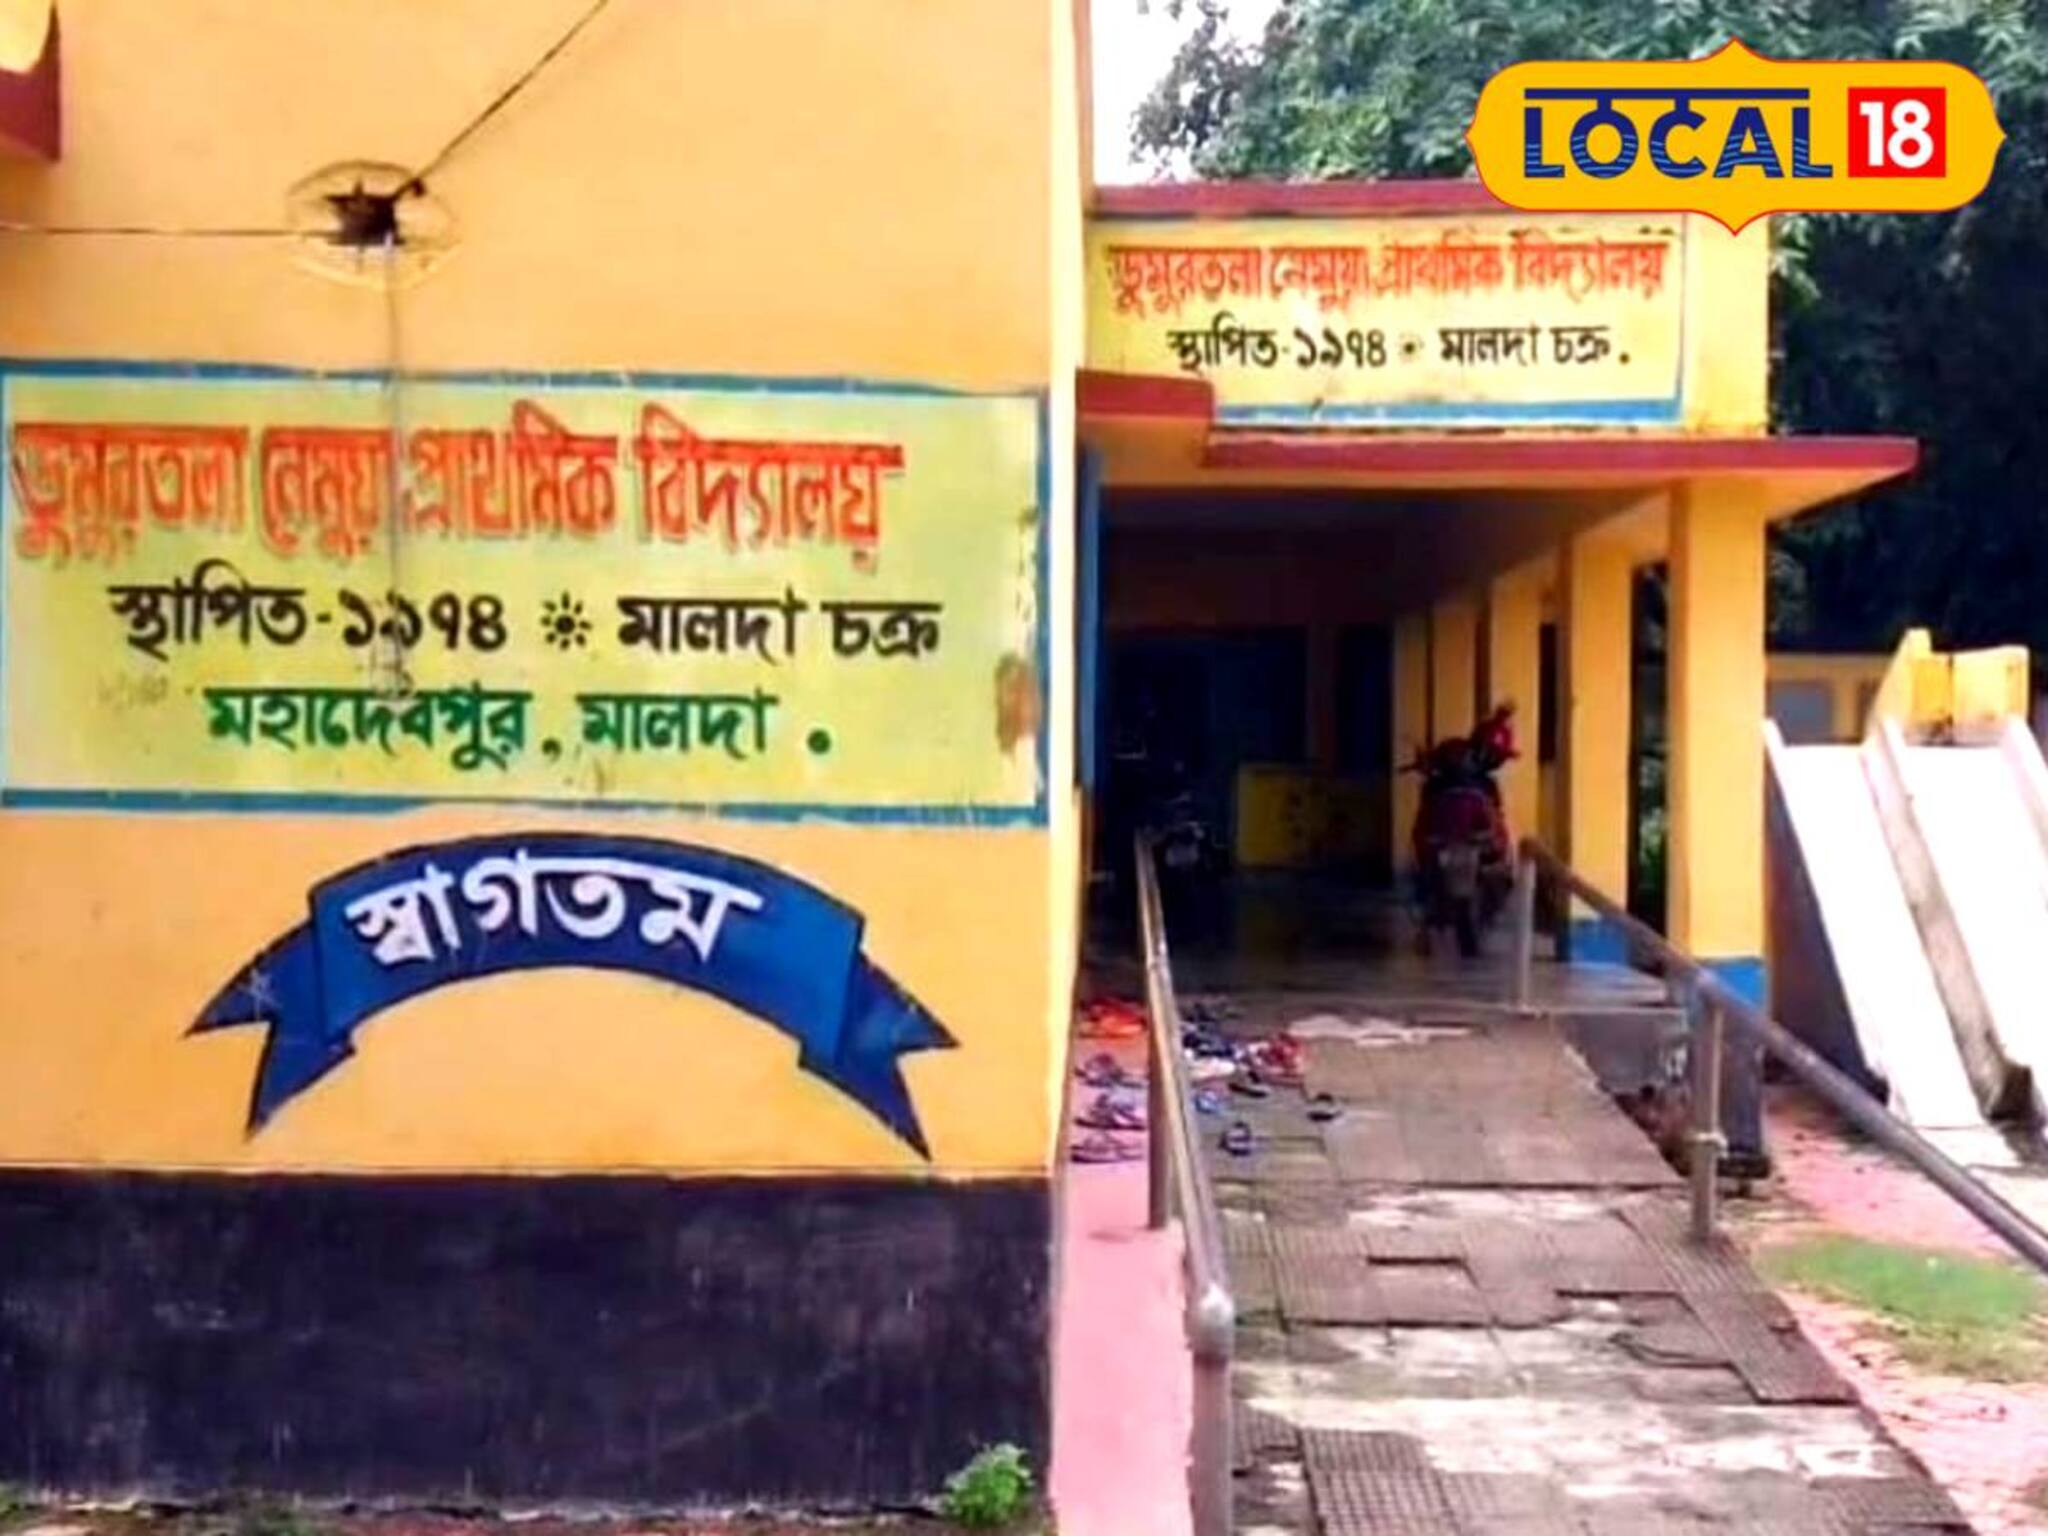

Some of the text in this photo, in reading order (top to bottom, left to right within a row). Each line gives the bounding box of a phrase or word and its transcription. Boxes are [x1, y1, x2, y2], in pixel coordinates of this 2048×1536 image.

[1507, 228, 1669, 302] বিদ্যালয়
[1438, 322, 1541, 366] মালদা
[402, 399, 618, 539] প্রাথমিক
[632, 401, 905, 575] বিদ্যালয়
[617, 586, 807, 665] মালদা
[821, 602, 942, 656] চক্র
[345, 847, 763, 965] স্বাগতম
